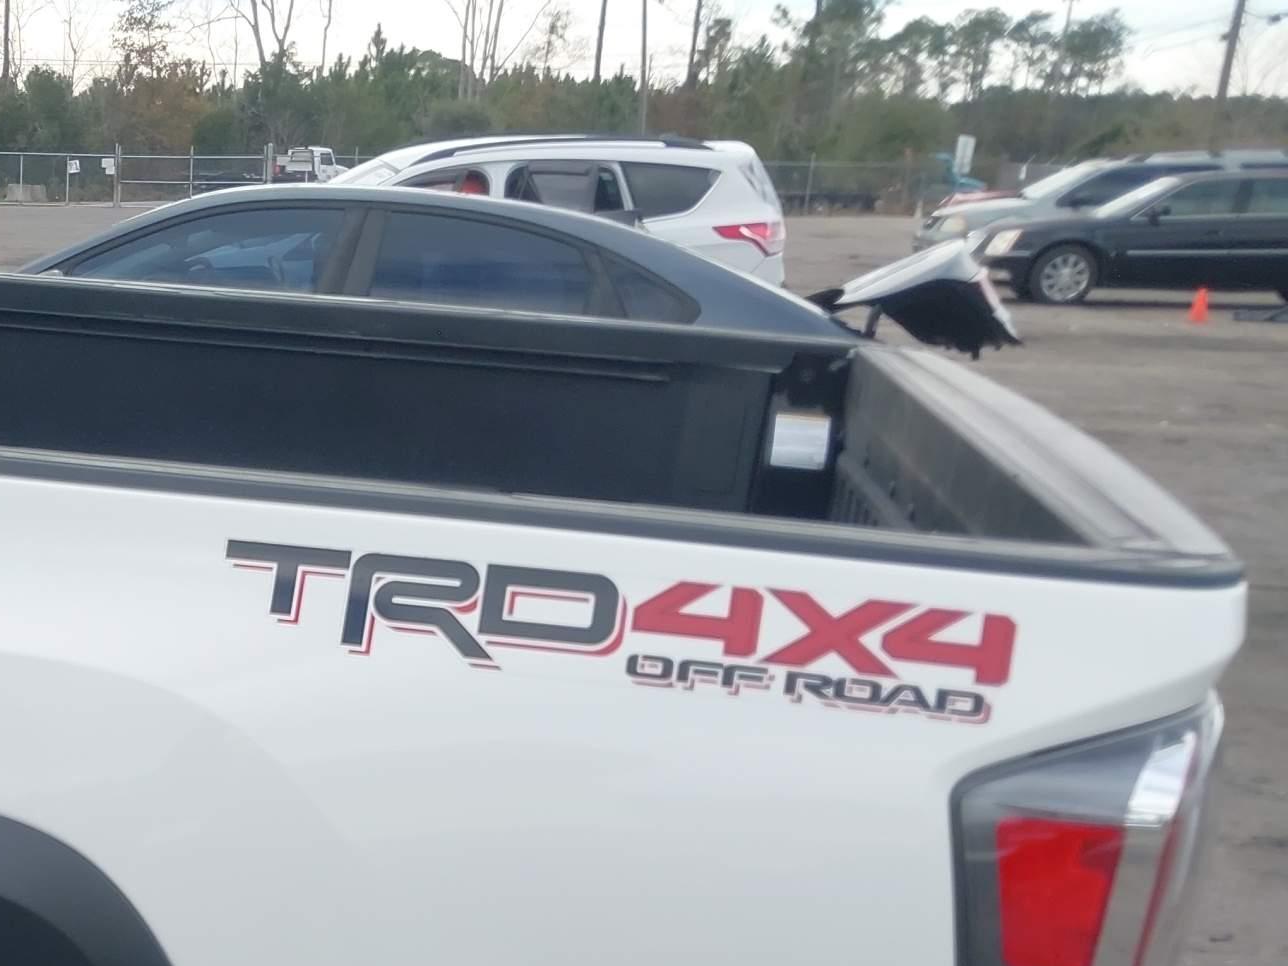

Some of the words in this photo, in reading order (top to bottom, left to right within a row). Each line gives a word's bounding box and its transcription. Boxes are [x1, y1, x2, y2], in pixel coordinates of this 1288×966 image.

[225, 539, 624, 671] TRD
[630, 580, 1017, 686] 4X4
[624, 653, 776, 696] OFF
[782, 669, 993, 724] ROAD
